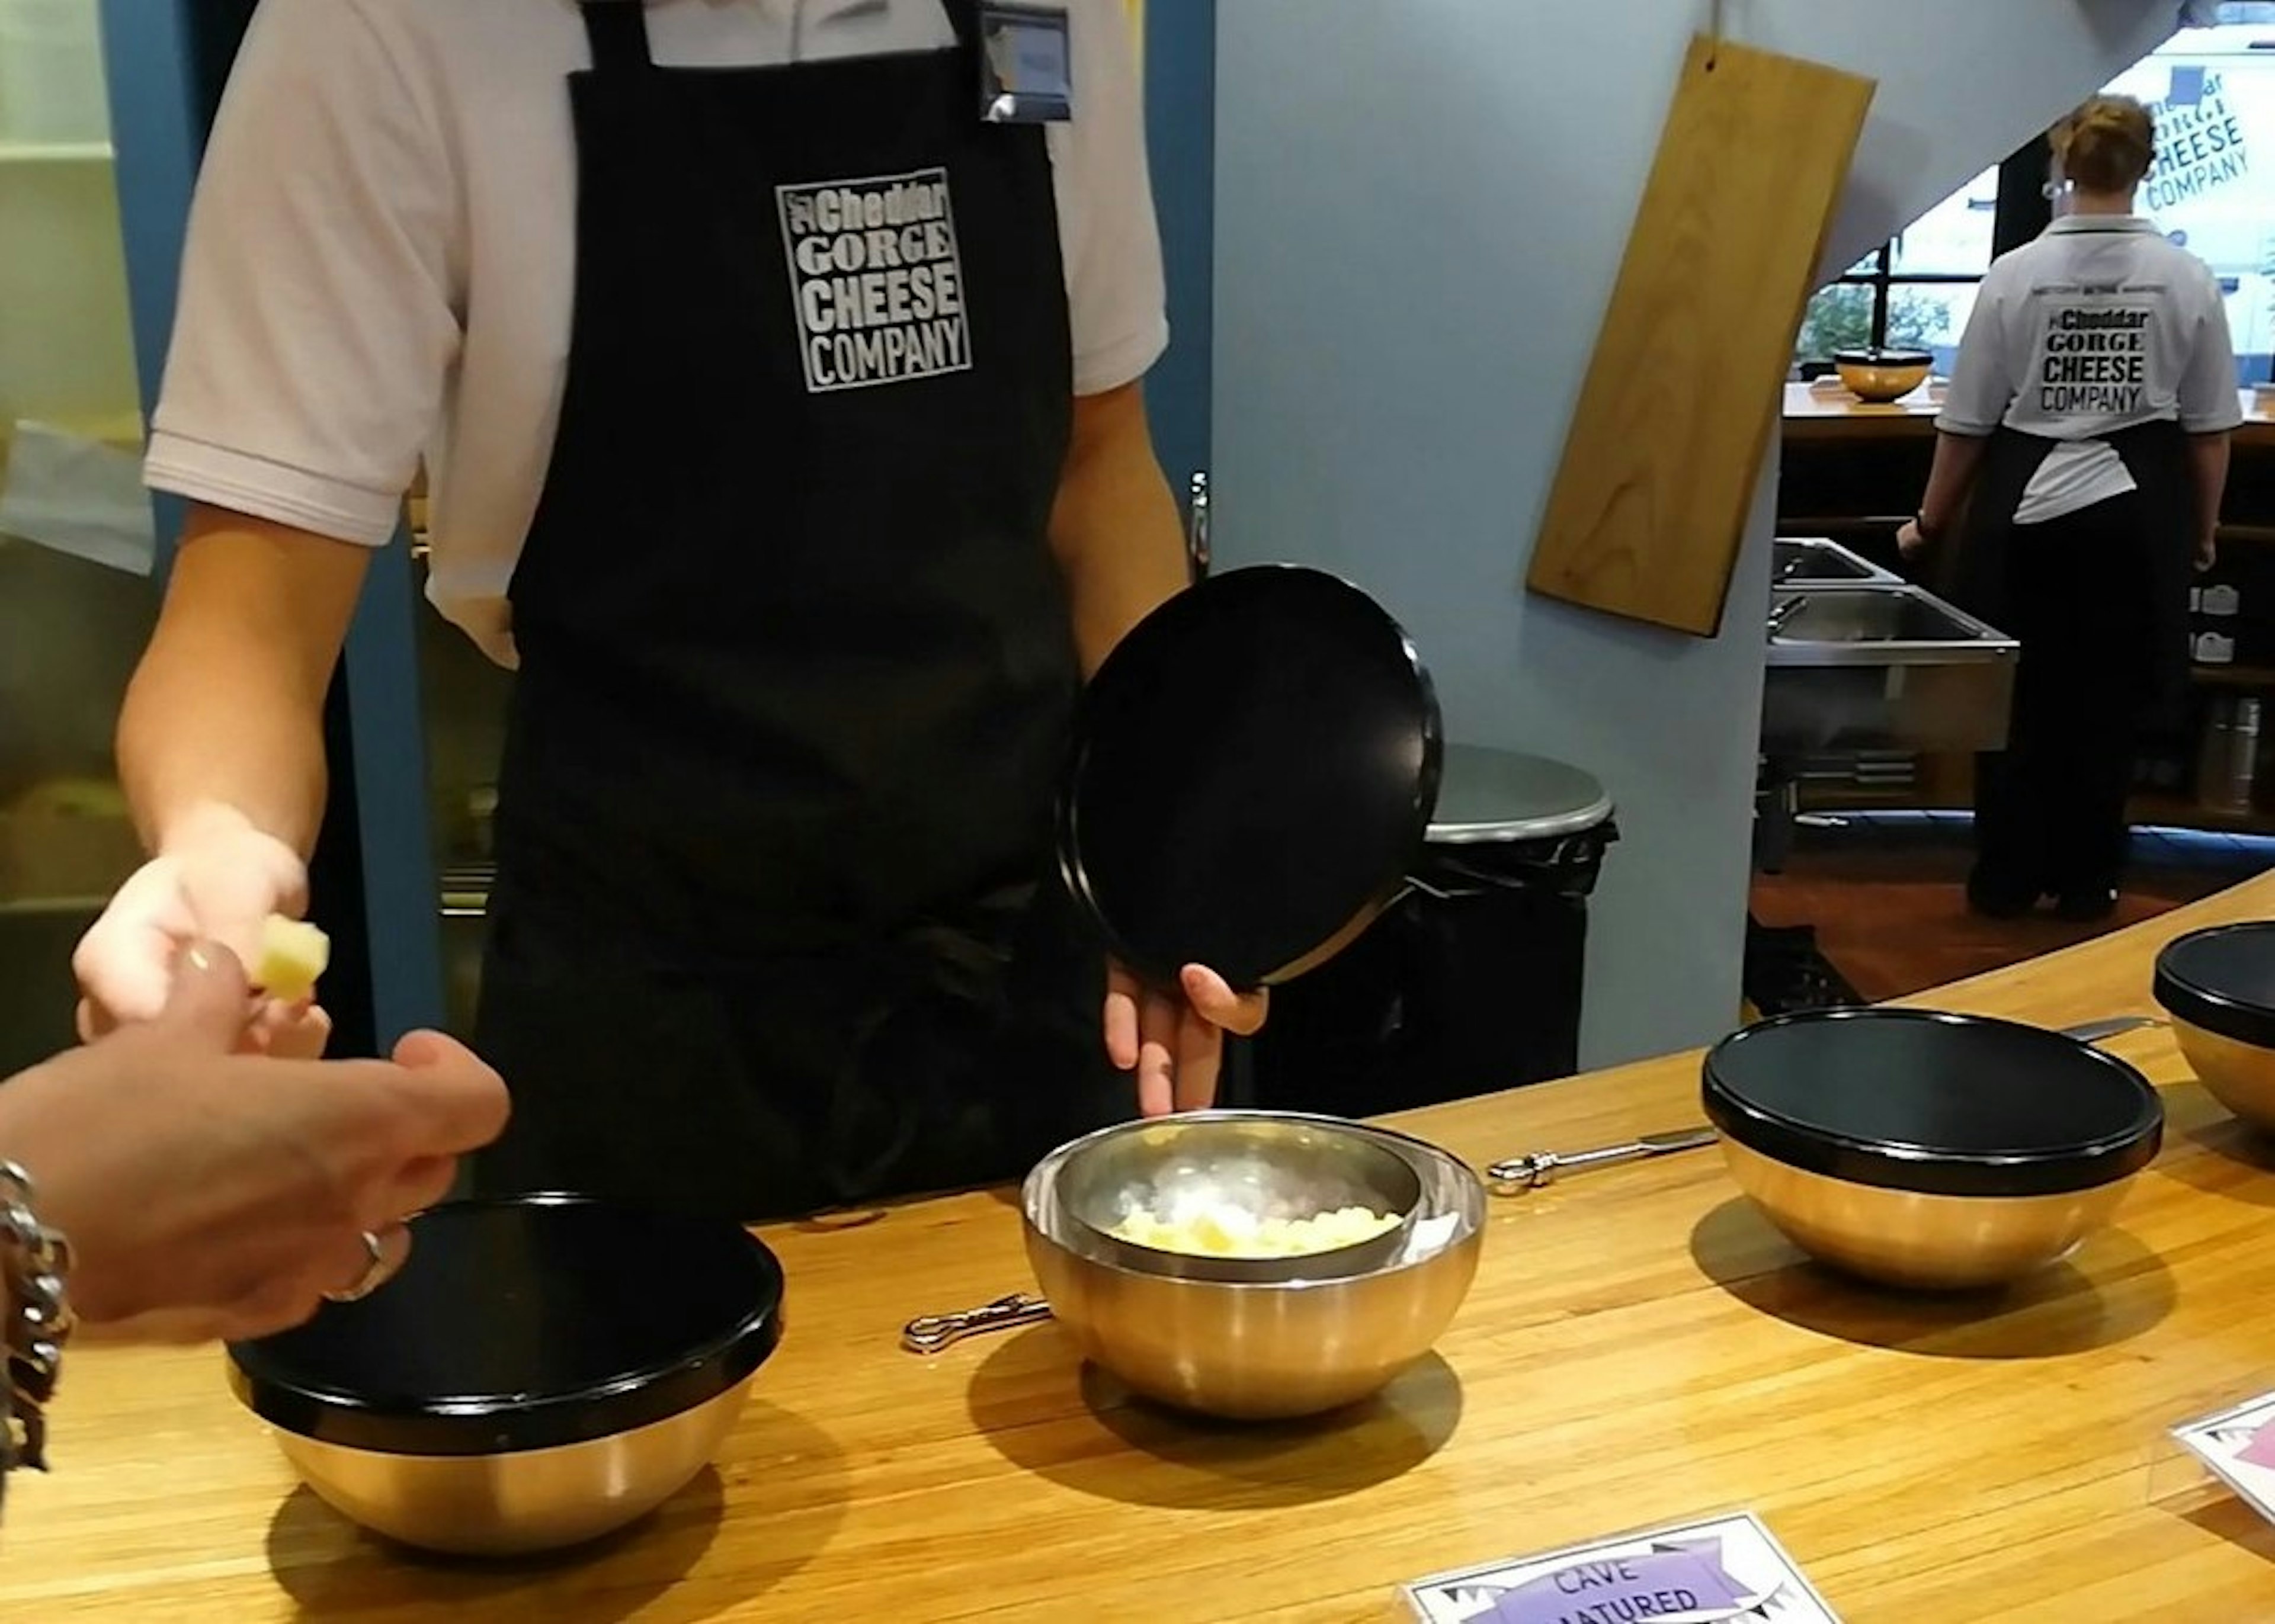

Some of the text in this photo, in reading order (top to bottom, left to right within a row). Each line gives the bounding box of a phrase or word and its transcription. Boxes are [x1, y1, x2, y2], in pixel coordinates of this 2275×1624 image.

[2145, 116, 2244, 180] HEESE
[2146, 146, 2249, 211] COMPANY
[796, 220, 949, 275] GORGE
[801, 261, 960, 333] CHEESE
[810, 318, 960, 385] COMPANY
[2043, 356, 2143, 383] CHEESE
[2047, 332, 2146, 352] GORGE
[2041, 386, 2142, 412] COMPANY
[1553, 1559, 1640, 1594] CAVE
